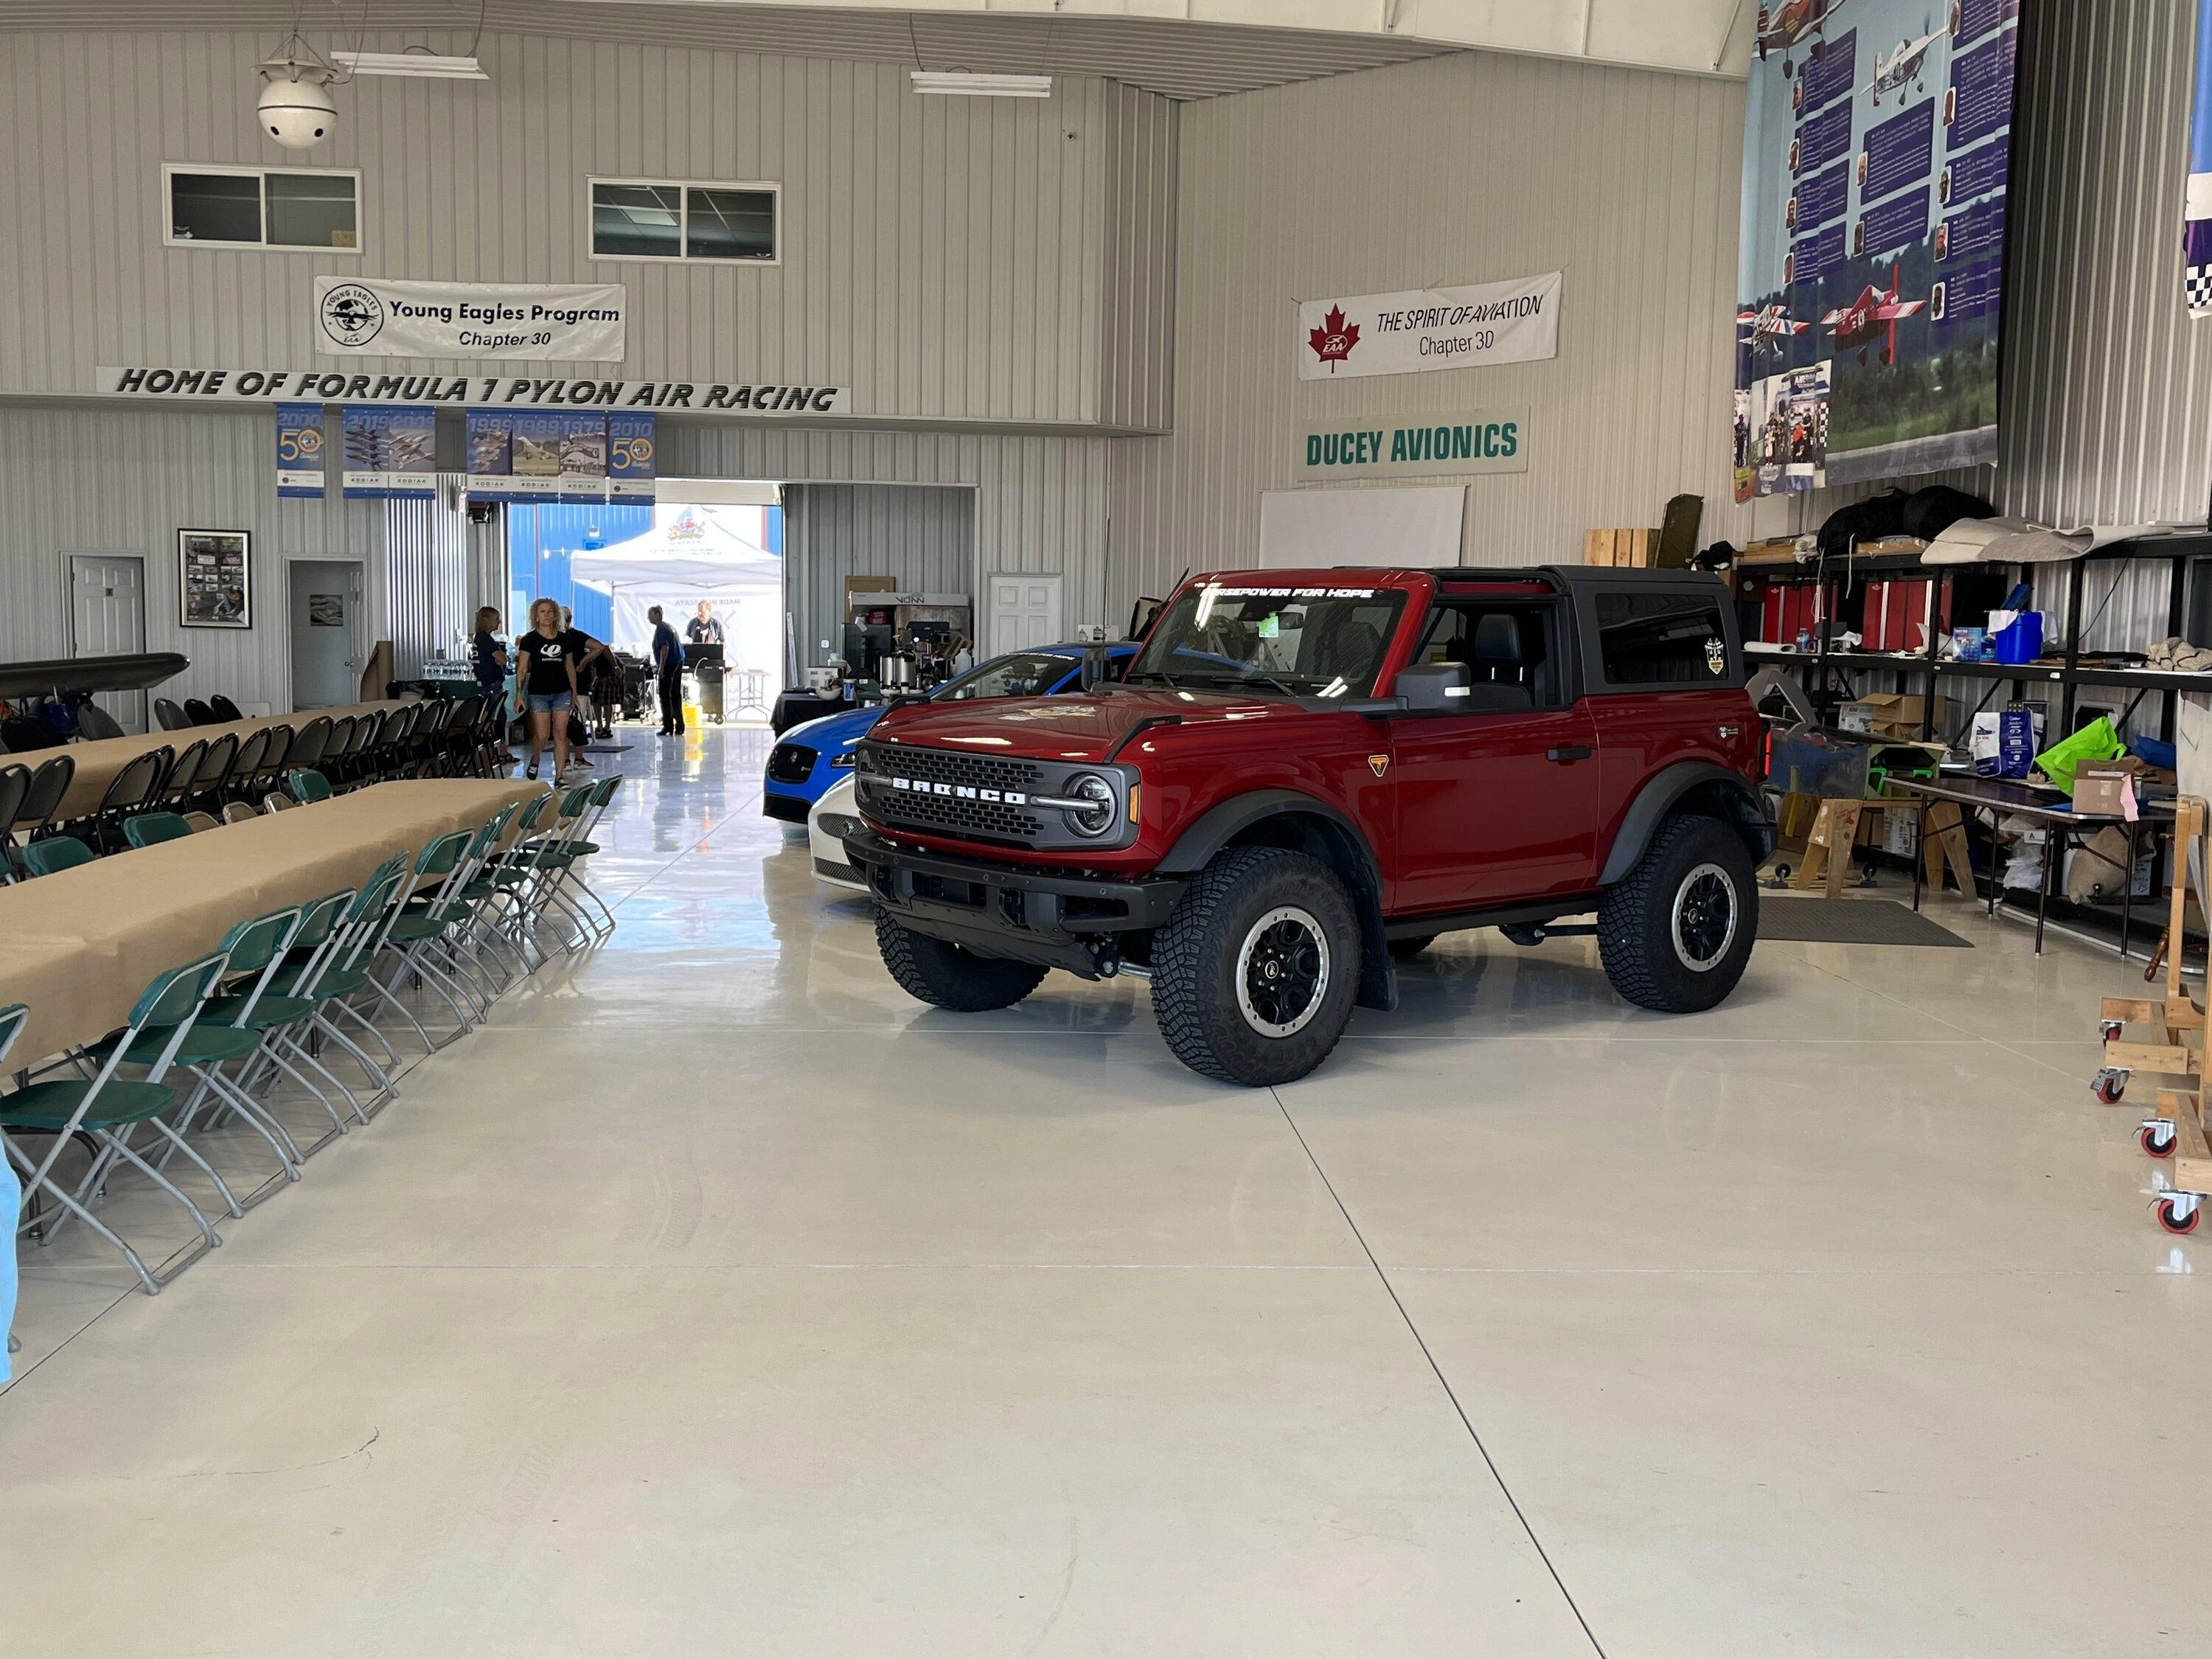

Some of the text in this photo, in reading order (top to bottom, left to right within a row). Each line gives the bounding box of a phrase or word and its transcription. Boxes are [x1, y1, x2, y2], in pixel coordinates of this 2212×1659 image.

[326, 290, 378, 310] YOUNG EAGLES
[389, 301, 619, 325] Young Eagles Program
[1377, 294, 1543, 333] THE SPIRIT OF AVIATION
[459, 331, 551, 349] Chapter 30
[1323, 343, 1343, 352] EAA
[1419, 330, 1494, 358] Chapter 30
[116, 368, 838, 411] HOME OF FORMULA 1 PYLON AIR RACING
[278, 413, 321, 426] 2000
[348, 414, 389, 429] 2019
[390, 415, 434, 428] 2009
[470, 418, 512, 433] 1999
[517, 420, 558, 434] 1989
[560, 420, 605, 435] 1979
[610, 422, 653, 437] 2010
[280, 428, 323, 461] 50
[1307, 422, 1517, 466] DUCEY AVIONICS
[612, 437, 653, 470] 50
[1292, 588, 1326, 597] FOR
[1326, 588, 1374, 598] HOPE
[893, 777, 1026, 805] BRONCO
